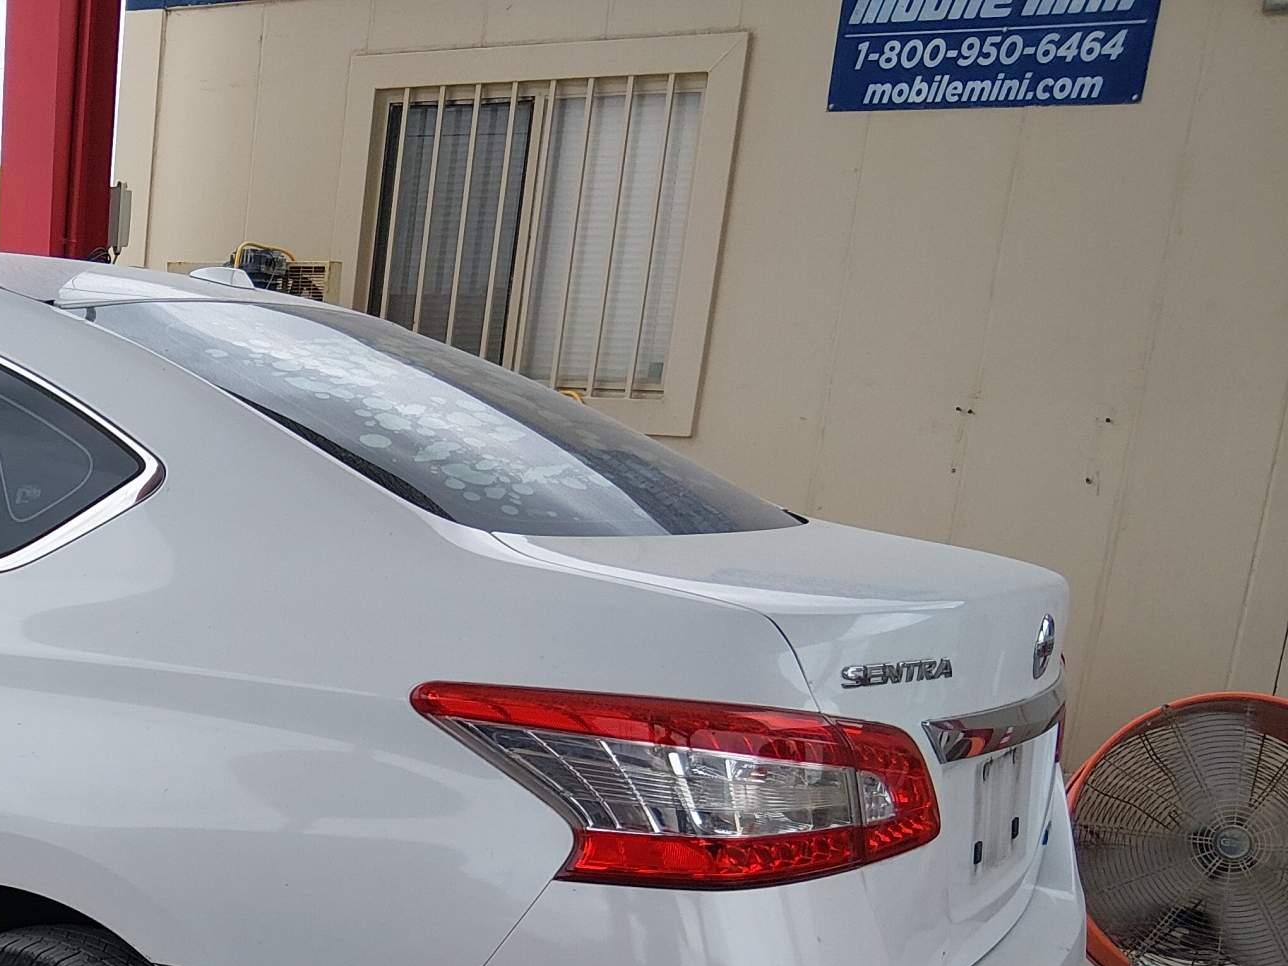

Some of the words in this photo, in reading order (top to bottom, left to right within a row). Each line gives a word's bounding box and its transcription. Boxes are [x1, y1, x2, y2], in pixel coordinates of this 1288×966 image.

[855, 29, 1129, 71] 1-800-950-6464
[862, 72, 1104, 105] mobilemini.com
[841, 657, 953, 690] SENTRA
